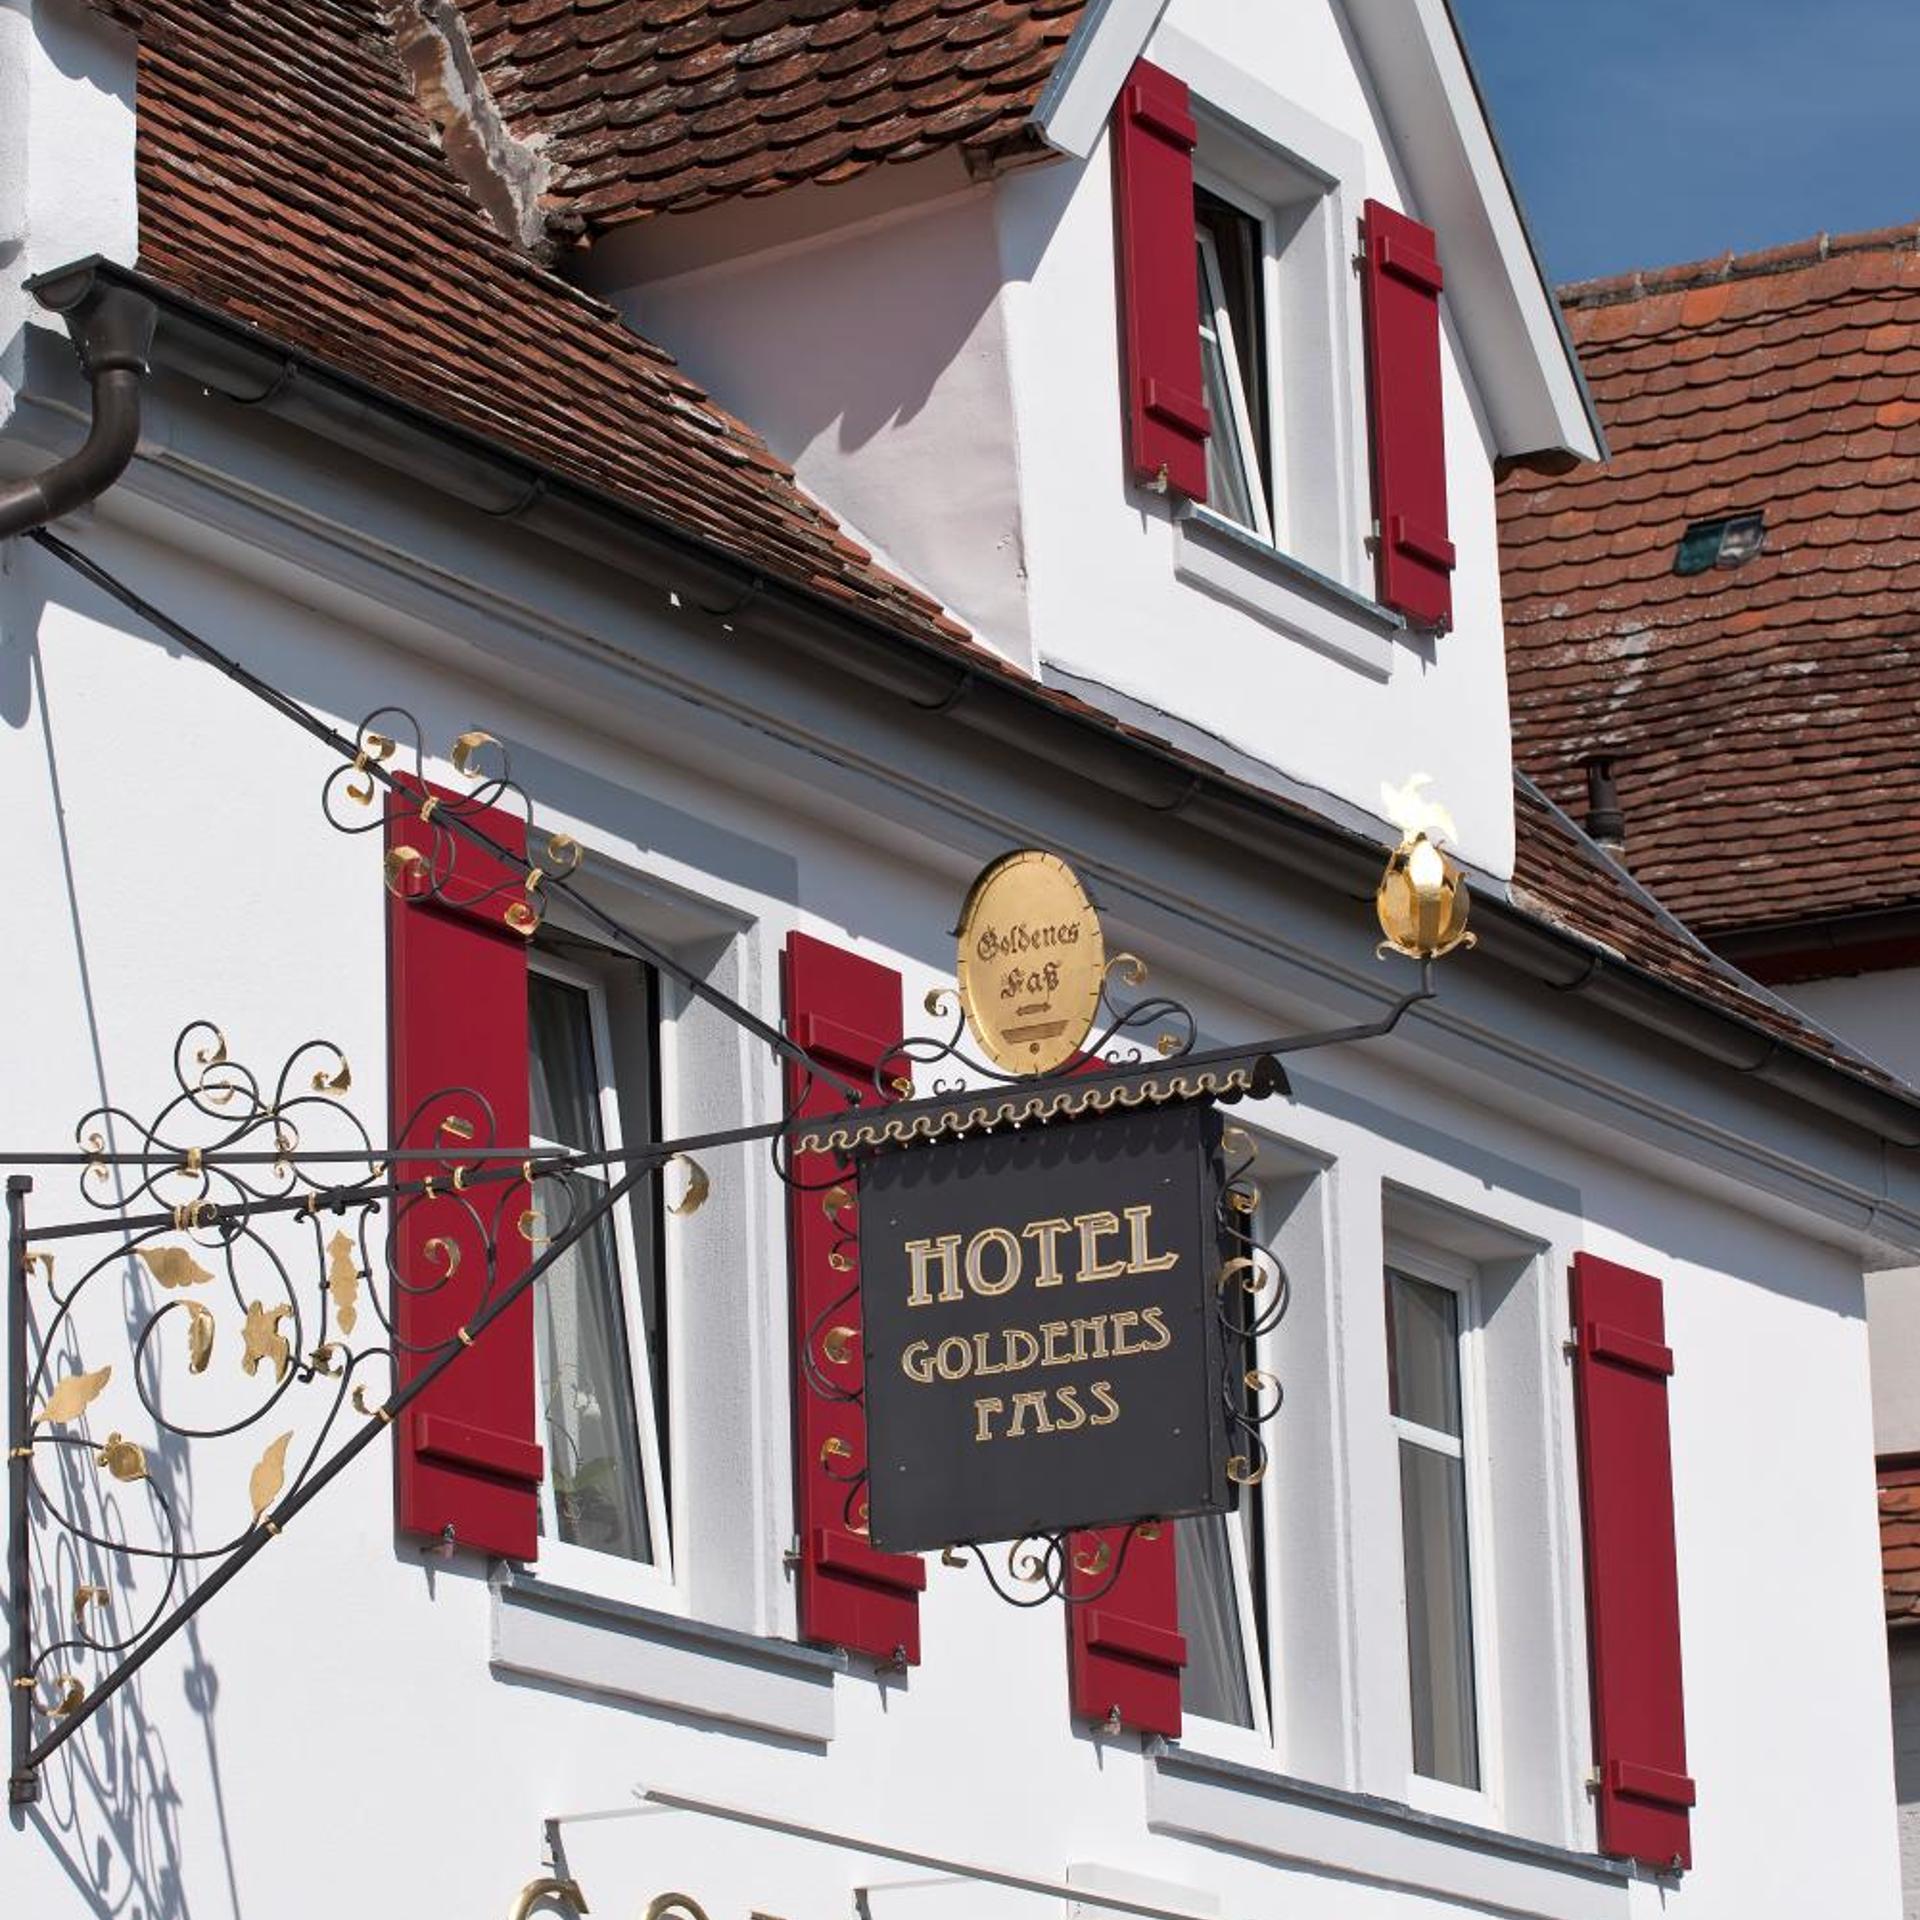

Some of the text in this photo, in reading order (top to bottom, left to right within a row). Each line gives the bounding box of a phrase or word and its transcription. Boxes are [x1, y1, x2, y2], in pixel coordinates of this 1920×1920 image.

[976, 922, 1081, 963] Goldenes
[904, 1204, 1180, 1307] HOTEL
[902, 1306, 1172, 1384] GOLDENES
[973, 1381, 1120, 1441] FASS
